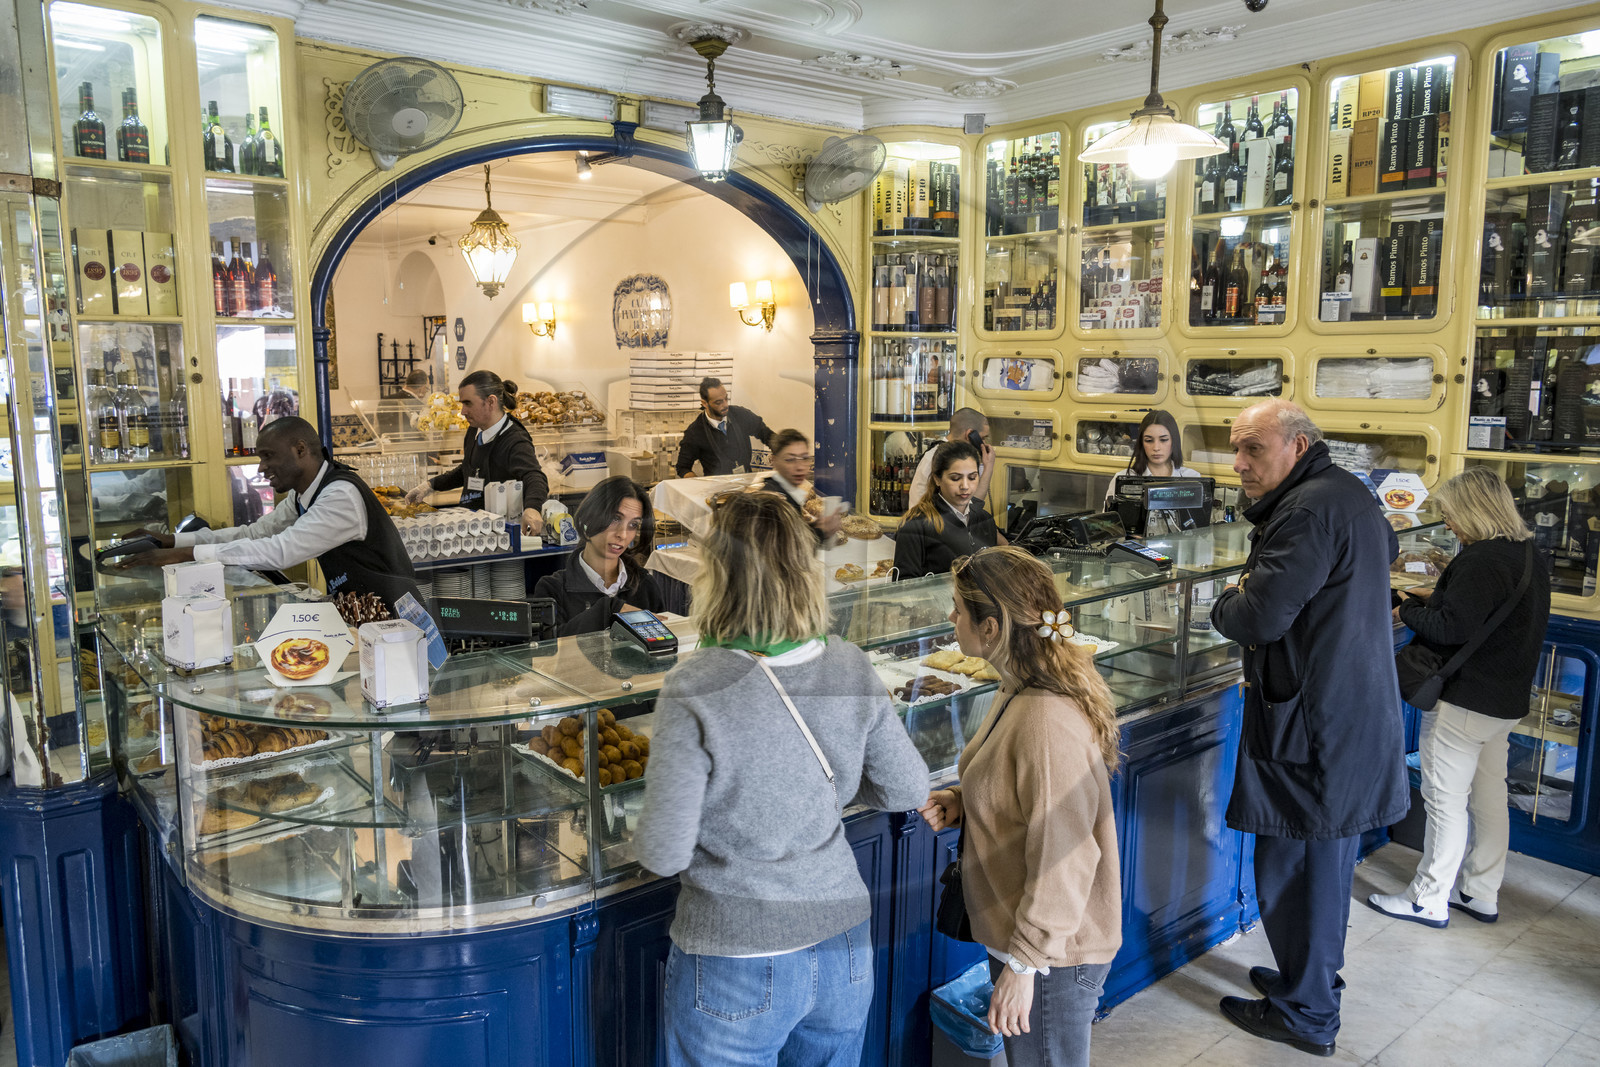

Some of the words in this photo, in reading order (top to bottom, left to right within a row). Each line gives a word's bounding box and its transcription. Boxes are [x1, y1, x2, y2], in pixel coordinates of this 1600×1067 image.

[1395, 71, 1404, 93] Pinto
[1424, 66, 1432, 88] Pinto
[1362, 109, 1381, 118] RP20
[1394, 93, 1403, 120] Ramos
[1422, 89, 1431, 116] Ramos
[1390, 122, 1399, 144] Pinto
[1417, 118, 1426, 140] Pinto
[1354, 160, 1373, 168] RP20
[1389, 144, 1398, 171] Ramos
[1415, 140, 1425, 167] Ramos
[1332, 154, 1343, 184] RP10
[1389, 238, 1398, 259] Pinto
[1420, 236, 1429, 257] Pinto
[1388, 260, 1397, 286] Ramos
[1418, 258, 1427, 285] Ramos
[292, 614, 320, 623] 1.50€
